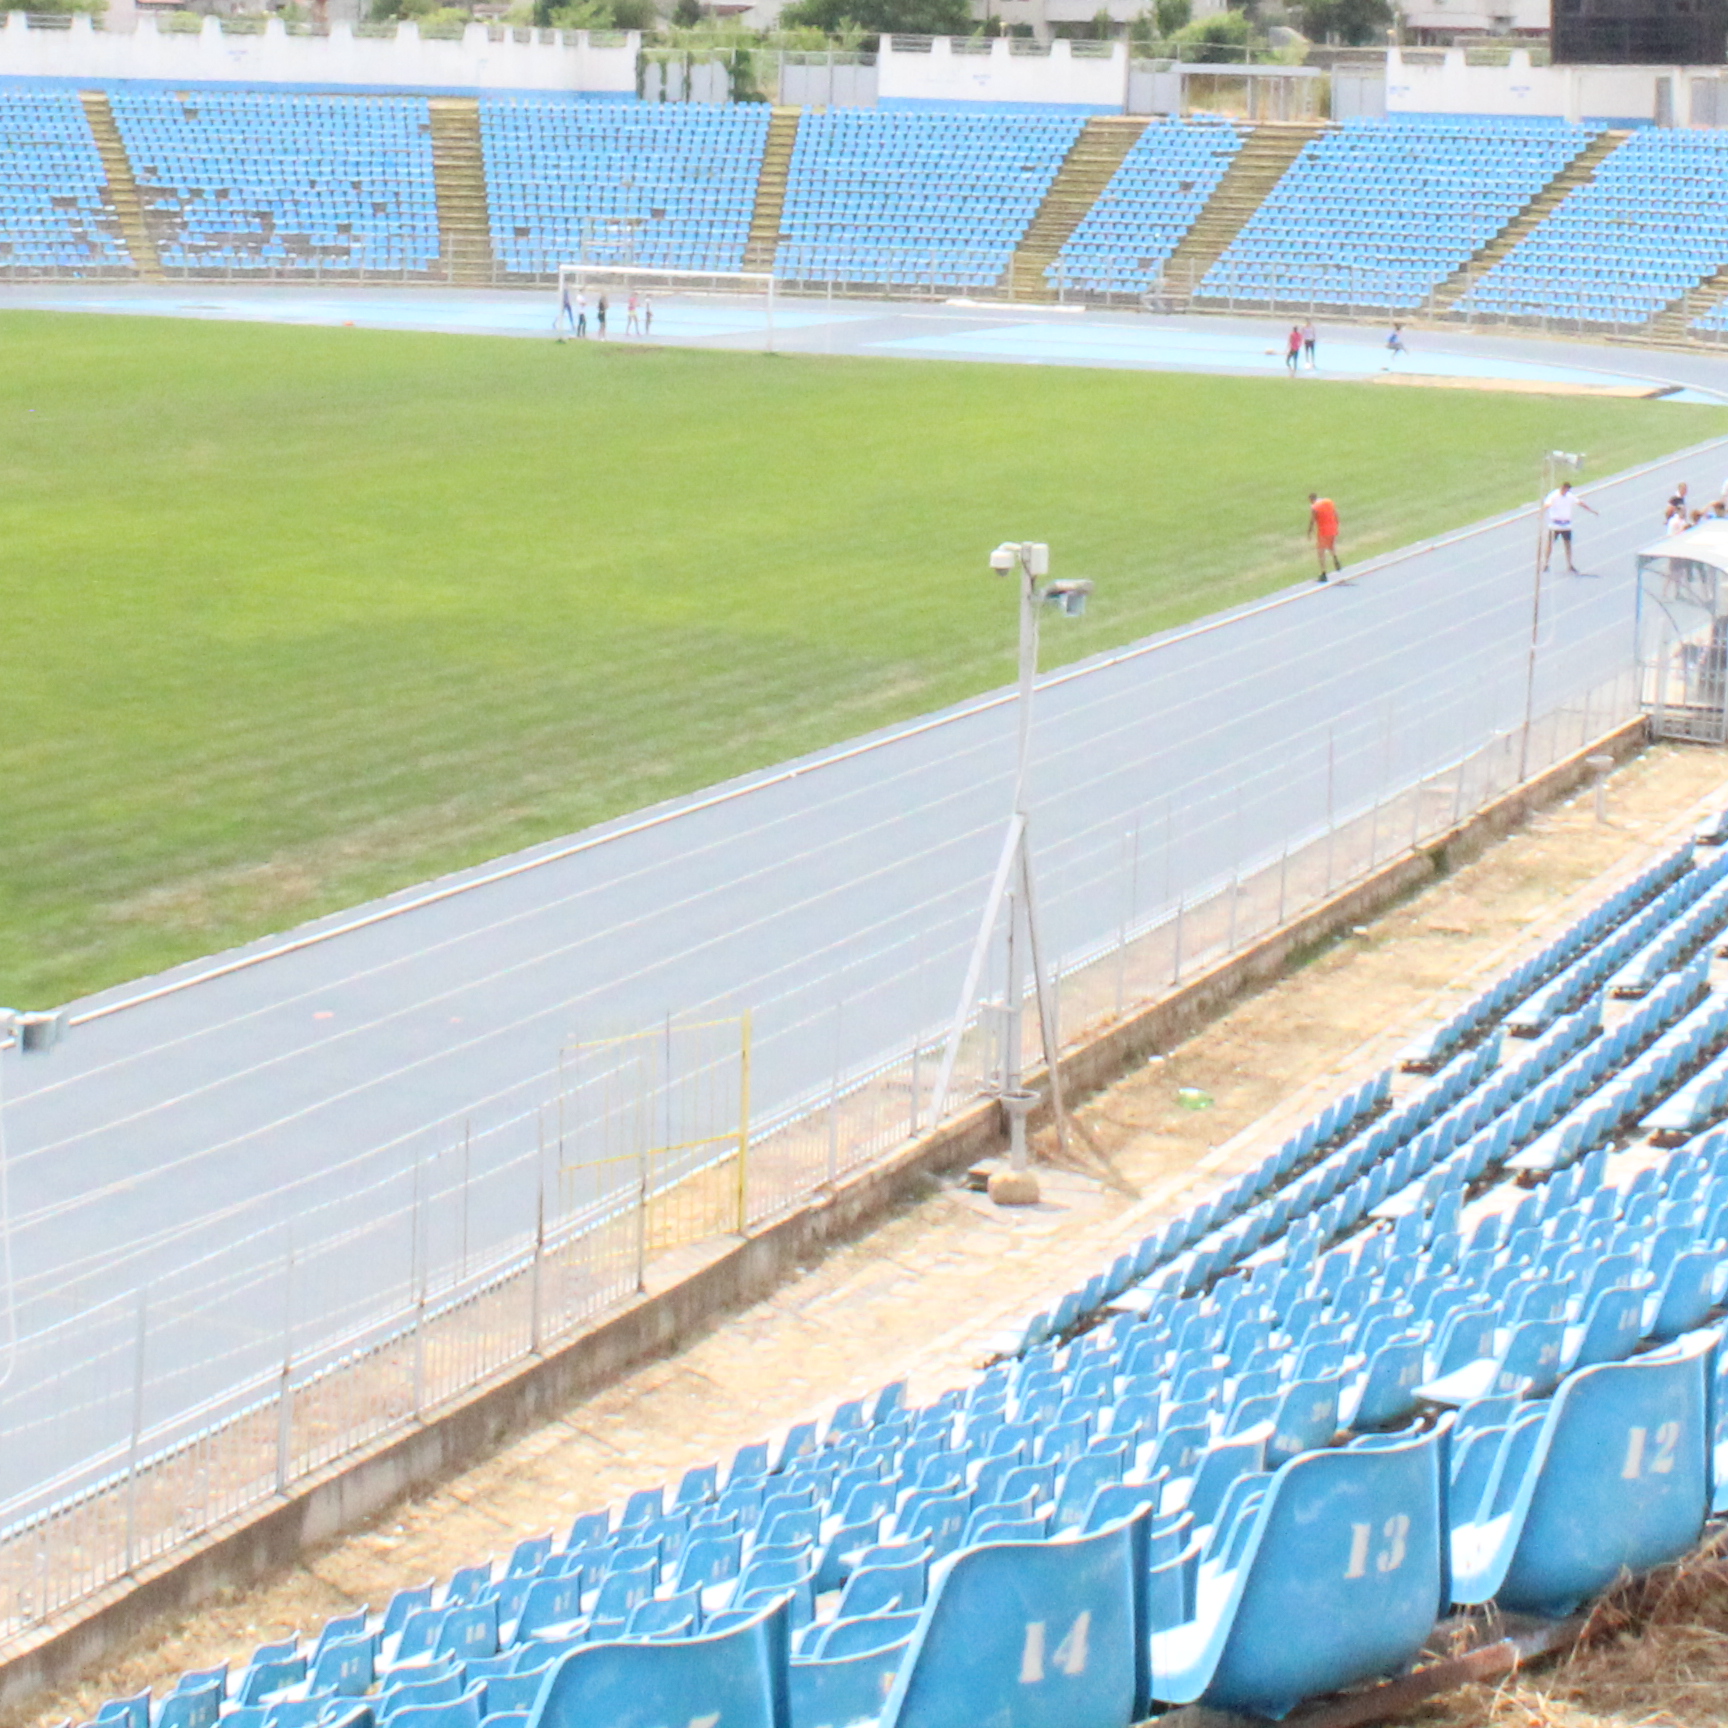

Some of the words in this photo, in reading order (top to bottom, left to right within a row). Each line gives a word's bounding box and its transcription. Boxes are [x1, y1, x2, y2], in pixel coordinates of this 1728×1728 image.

[1621, 1422, 1681, 1479] 12
[1344, 1514, 1410, 1579] 13
[1020, 1611, 1091, 1684] 14
